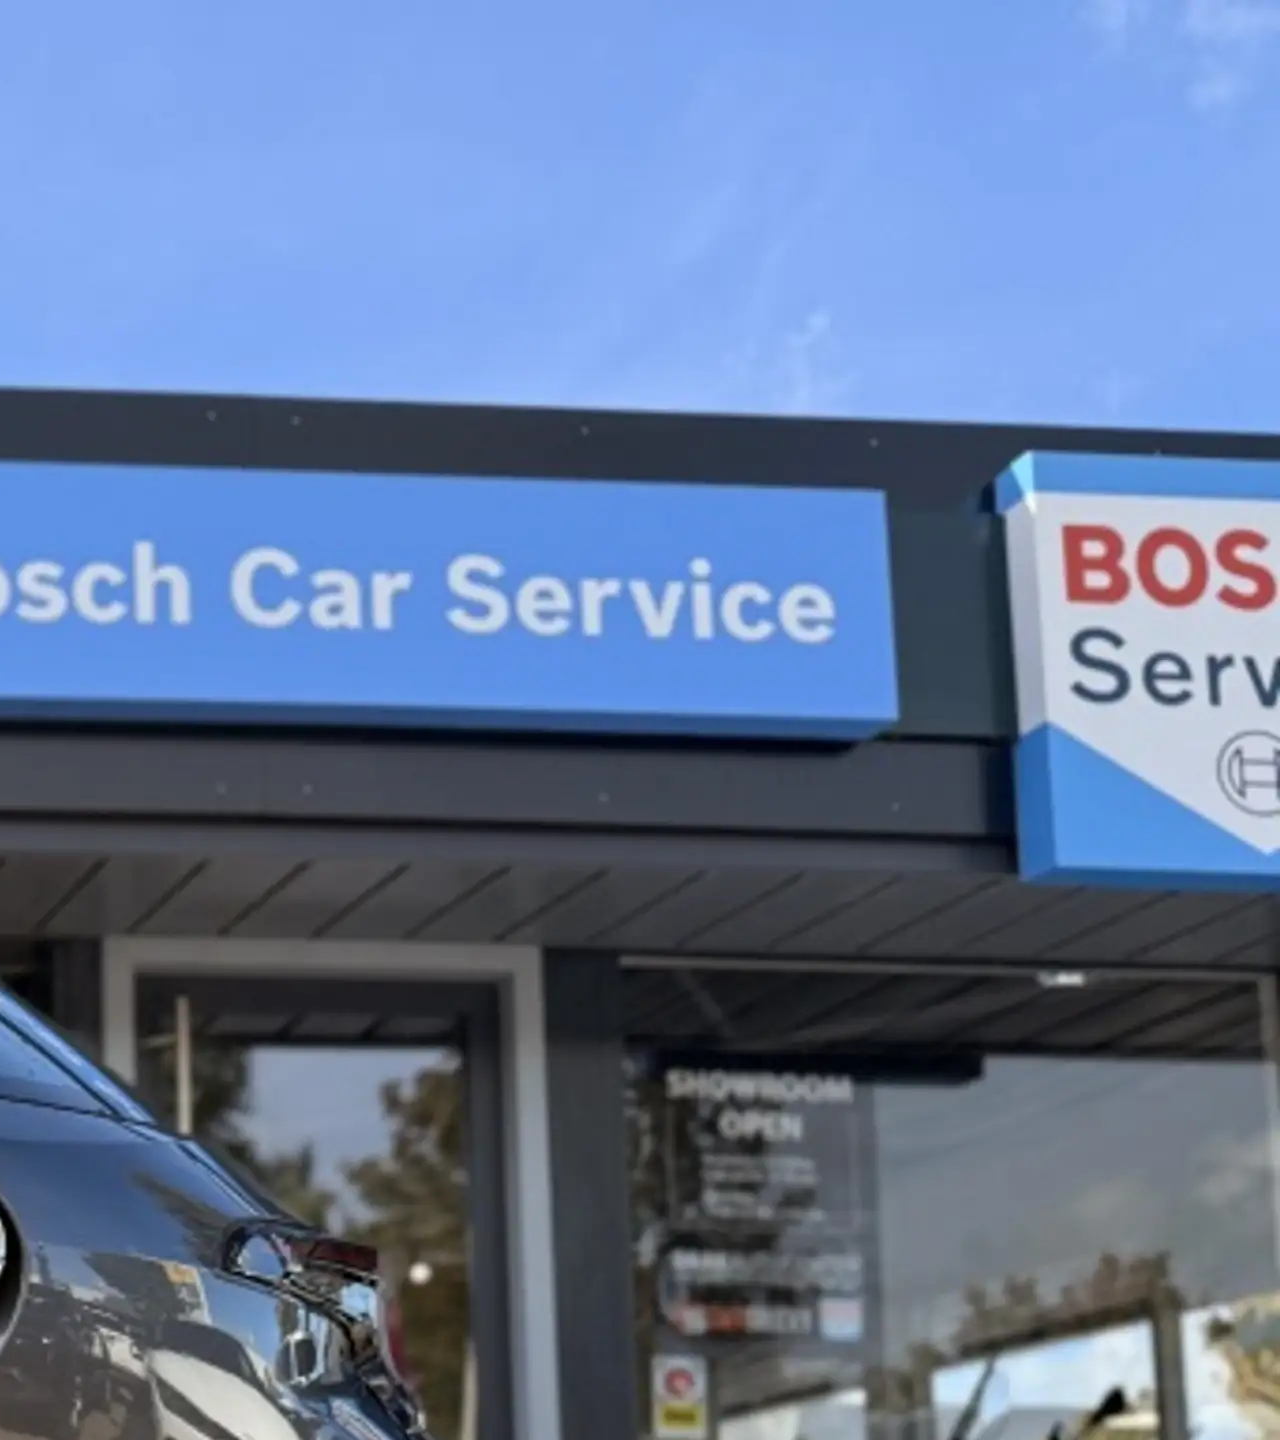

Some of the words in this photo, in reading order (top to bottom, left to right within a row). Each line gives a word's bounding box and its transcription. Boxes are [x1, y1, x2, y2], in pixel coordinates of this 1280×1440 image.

[230, 546, 412, 630] Car
[445, 553, 837, 644] Service
[1062, 524, 1278, 611] BOS
[666, 1068, 854, 1105] SHOWROOM
[717, 1106, 804, 1143] OPEN
